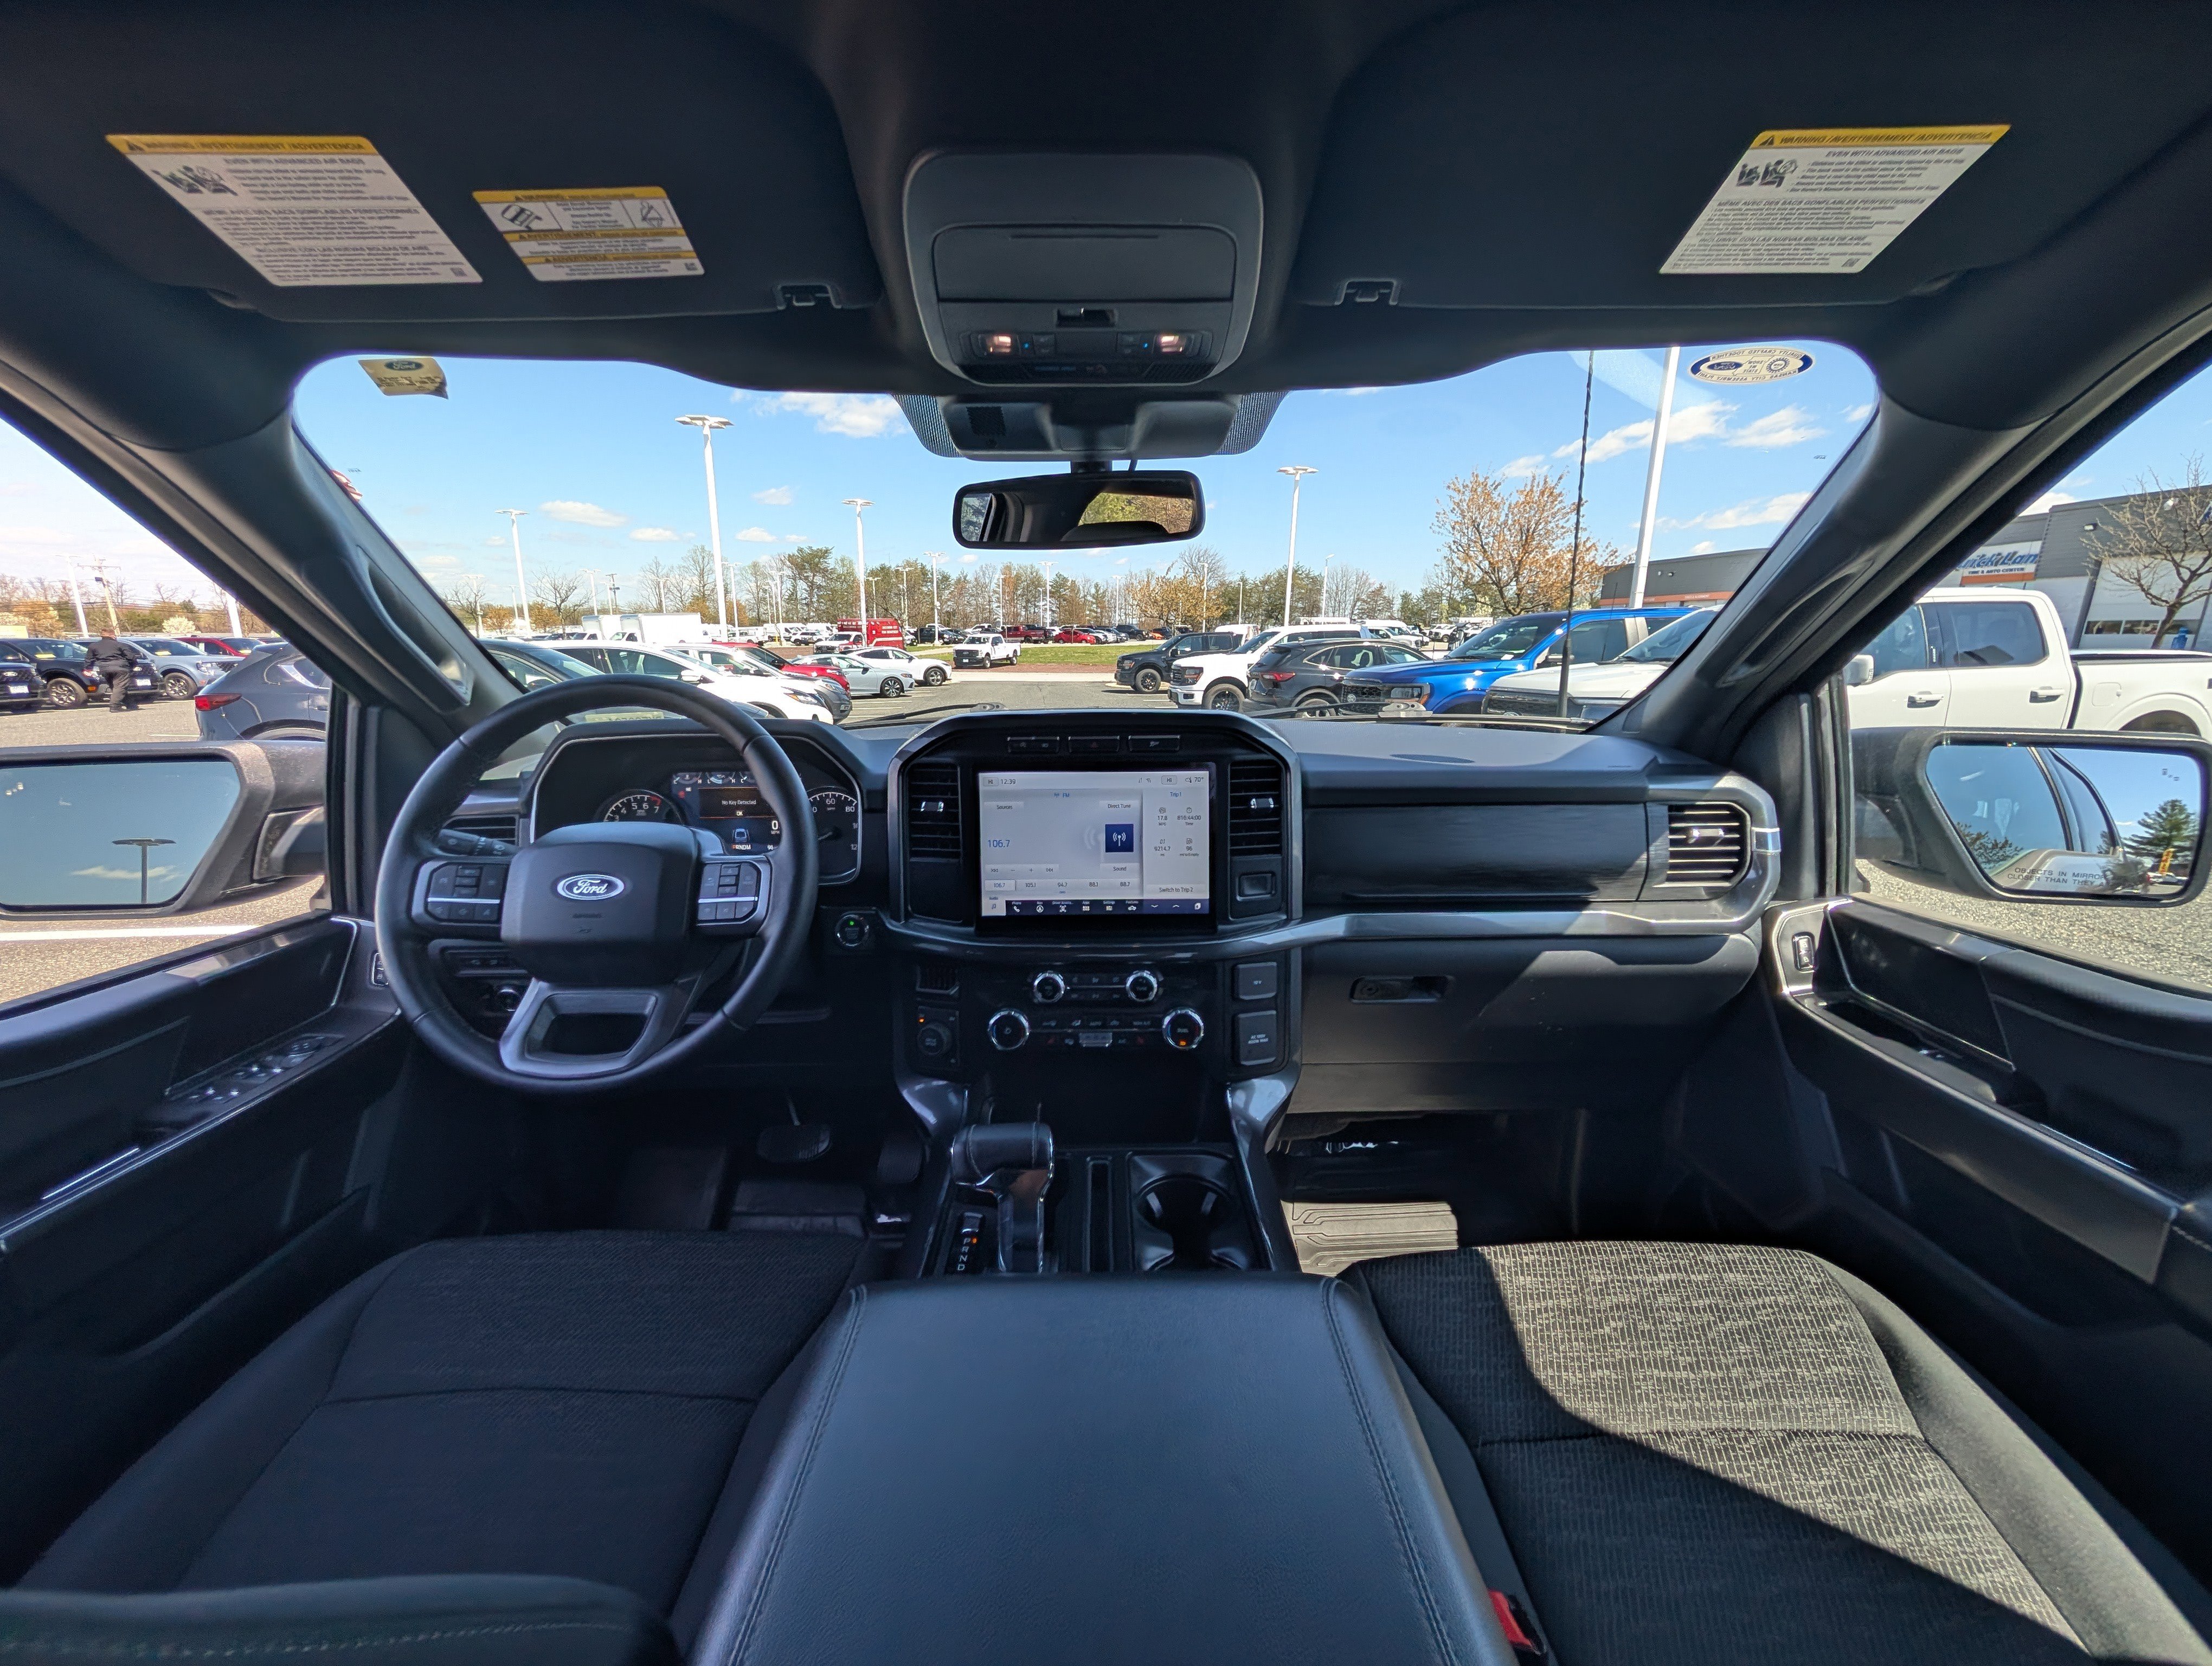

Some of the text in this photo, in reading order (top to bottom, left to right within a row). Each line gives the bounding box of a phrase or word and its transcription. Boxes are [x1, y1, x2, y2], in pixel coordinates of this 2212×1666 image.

[1779, 136, 1827, 144] WARNING
[1999, 551, 2039, 566] Lan
[771, 820, 779, 830] 0
[987, 840, 1011, 848] 106.7
[2014, 867, 2053, 875] OBJECTS
[2007, 873, 2040, 882] CLOSER
[573, 879, 608, 894] Ford
